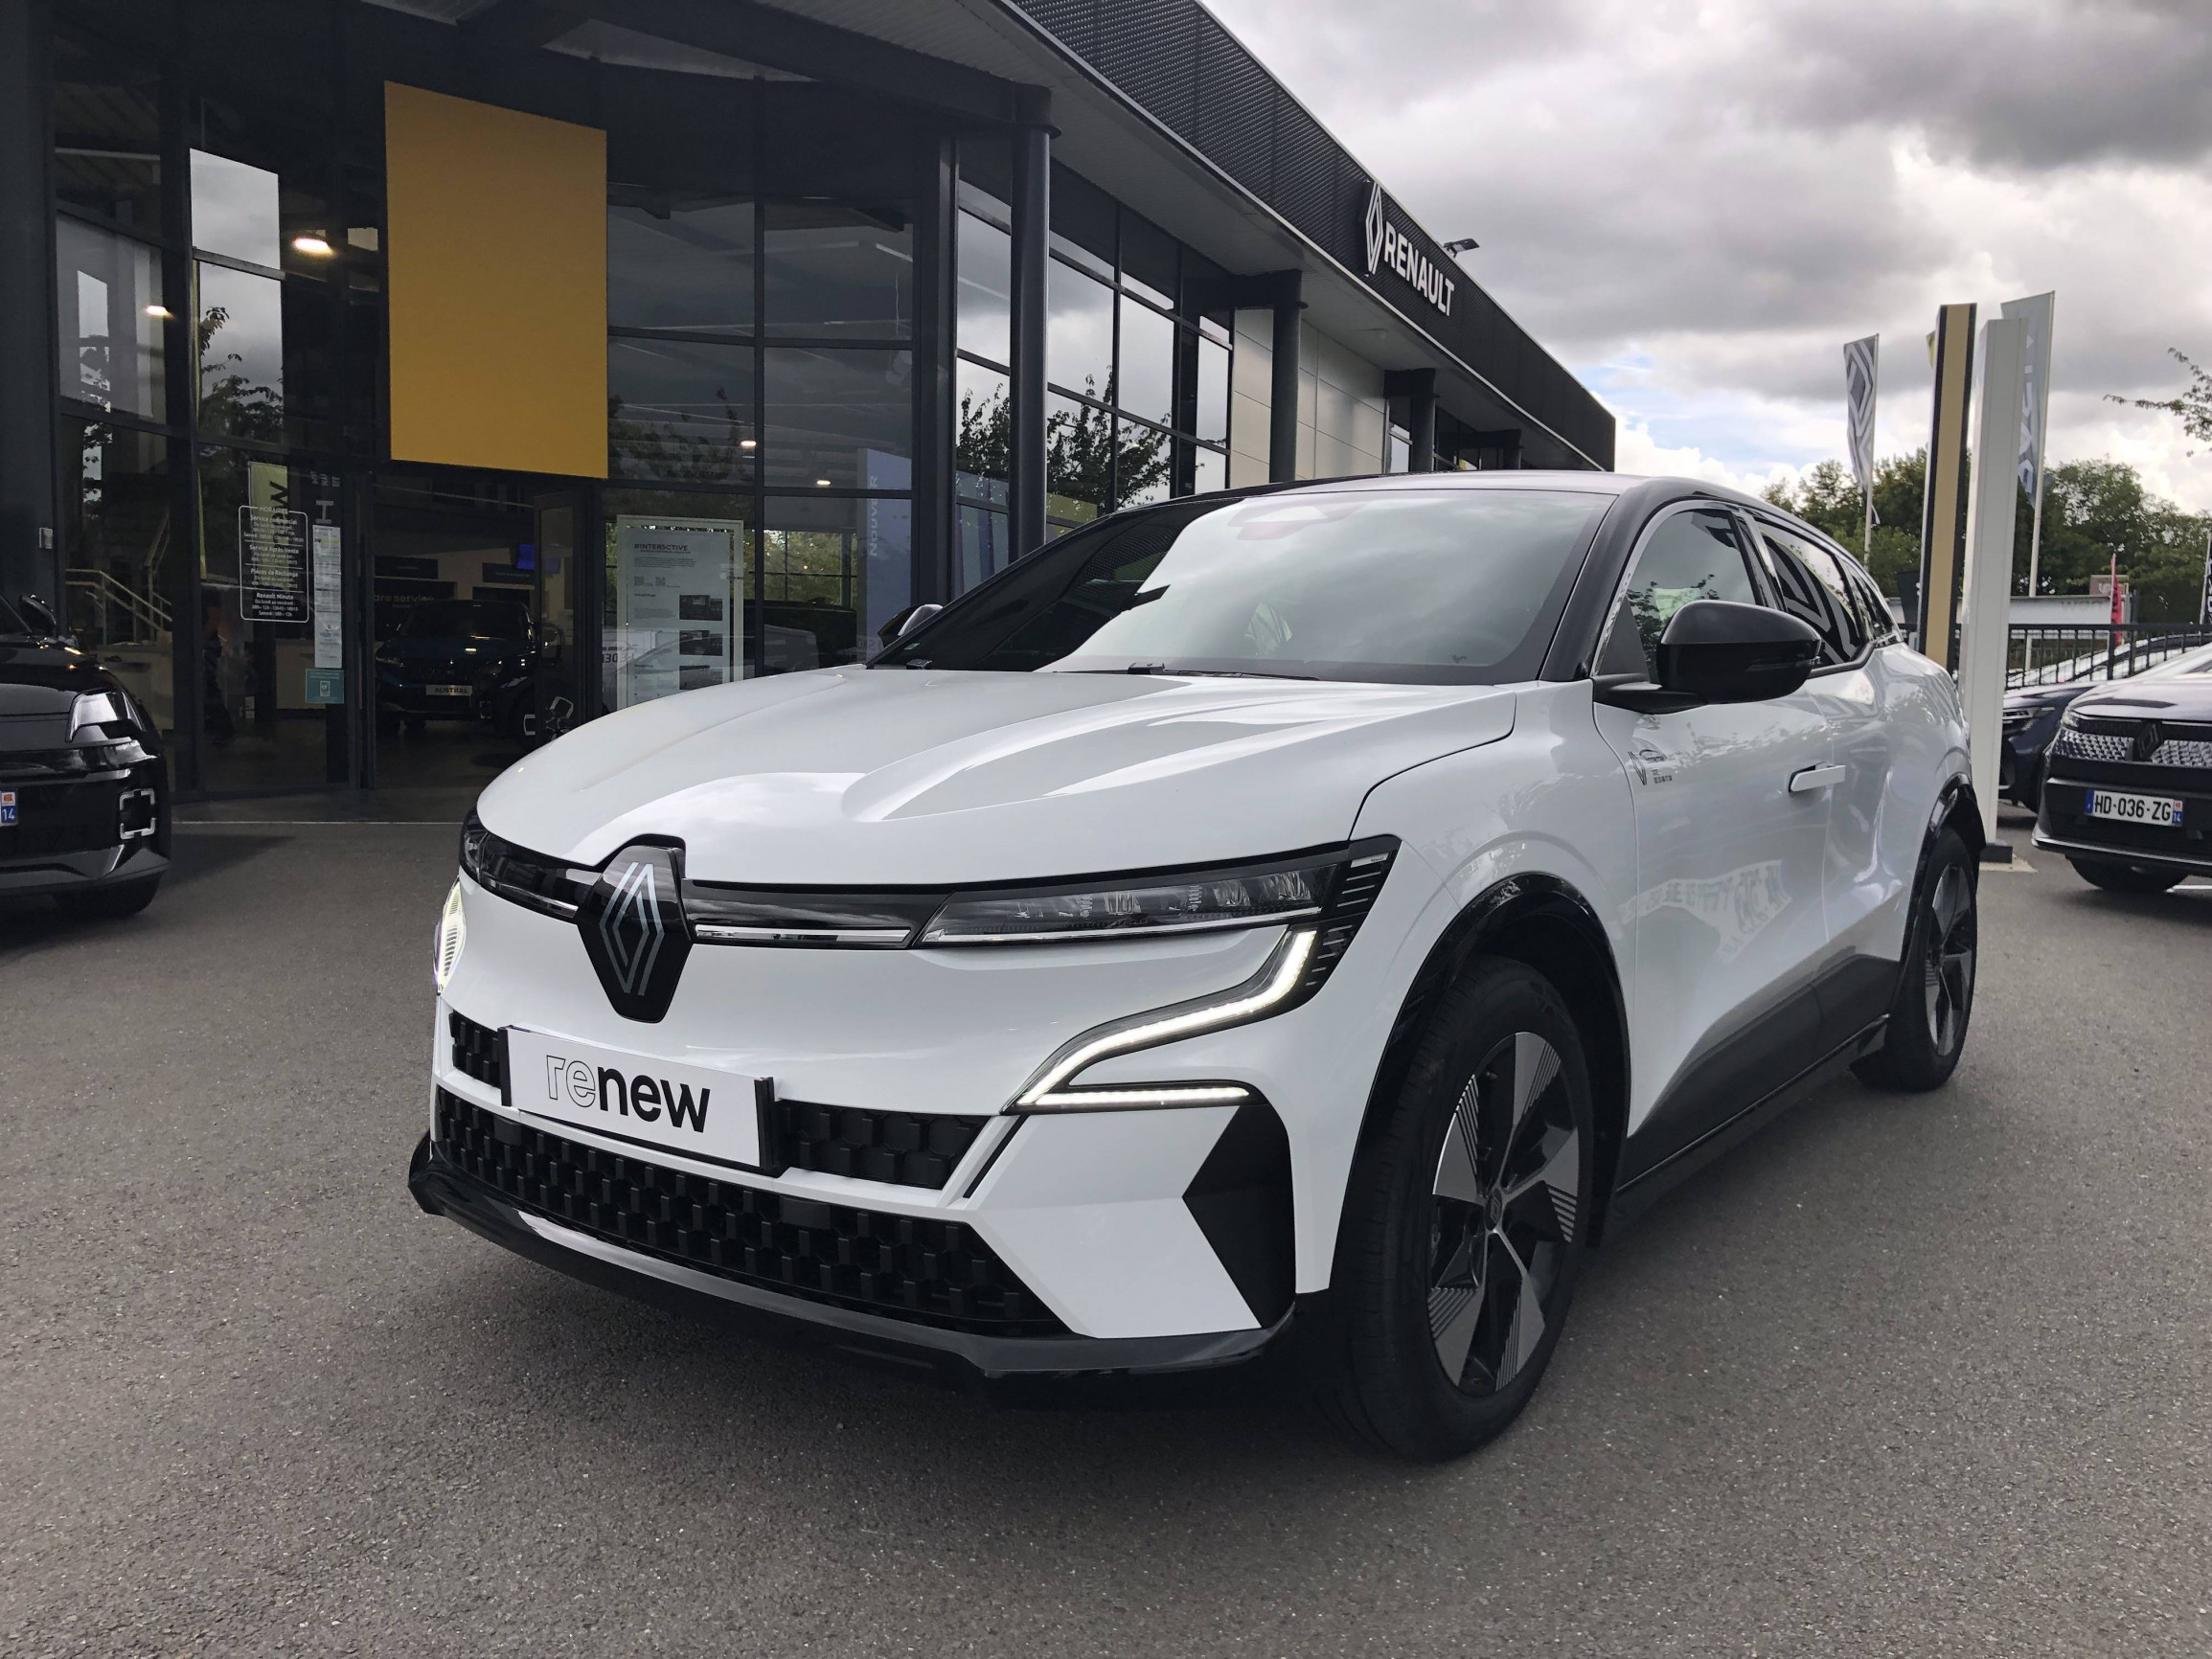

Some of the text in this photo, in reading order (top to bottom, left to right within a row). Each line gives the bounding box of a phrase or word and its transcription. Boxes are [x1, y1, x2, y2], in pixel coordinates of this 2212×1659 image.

[1384, 221, 1454, 316] RENAULT
[2, 807, 15, 822] 14
[2094, 794, 2172, 822] HD-036-ZG
[2173, 813, 2181, 823] 14
[546, 1056, 712, 1133] renew
